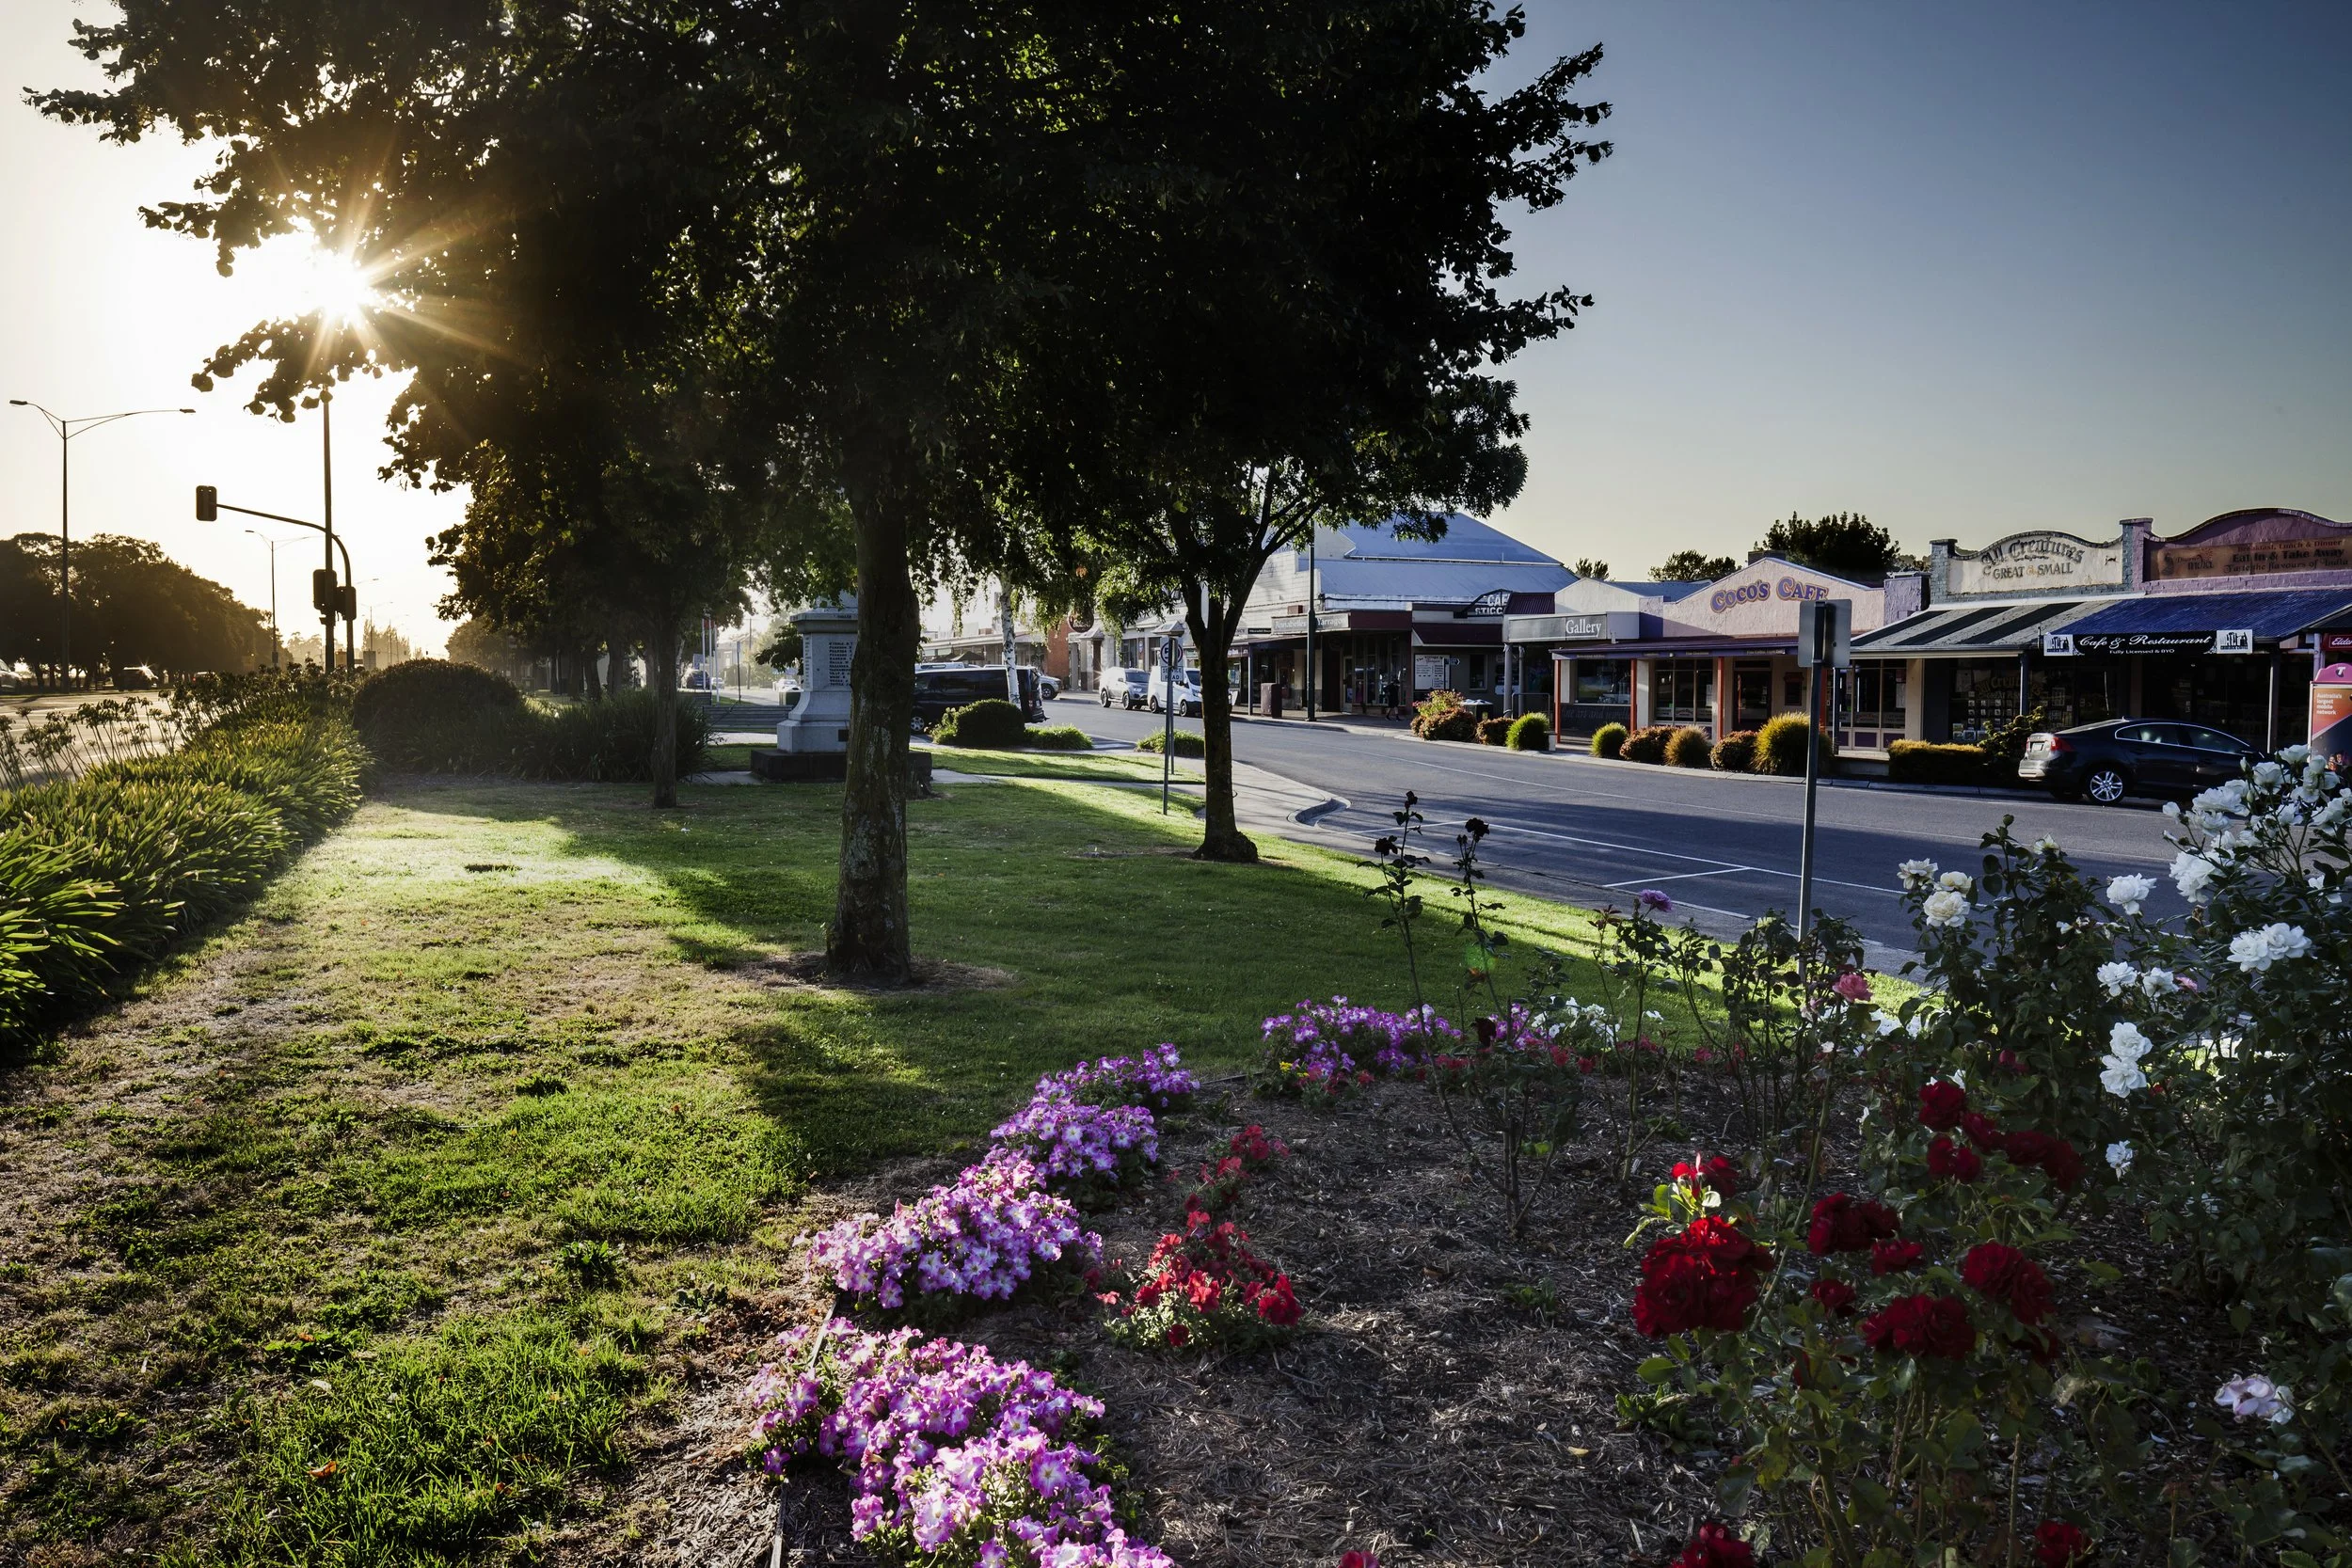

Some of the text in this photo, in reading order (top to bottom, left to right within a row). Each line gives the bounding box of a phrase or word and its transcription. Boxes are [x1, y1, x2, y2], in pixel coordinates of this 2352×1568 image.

[2008, 537, 2085, 563] Creatures
[2233, 548, 2344, 562] Eat In & Take Away
[1993, 566, 2025, 579] GREAT
[2038, 562, 2074, 576] SMALL
[1487, 594, 1510, 607] CAF
[1475, 607, 1507, 615] STICC
[1565, 619, 1601, 637] Gallery
[2078, 634, 2212, 649] Cafe & Restaurant
